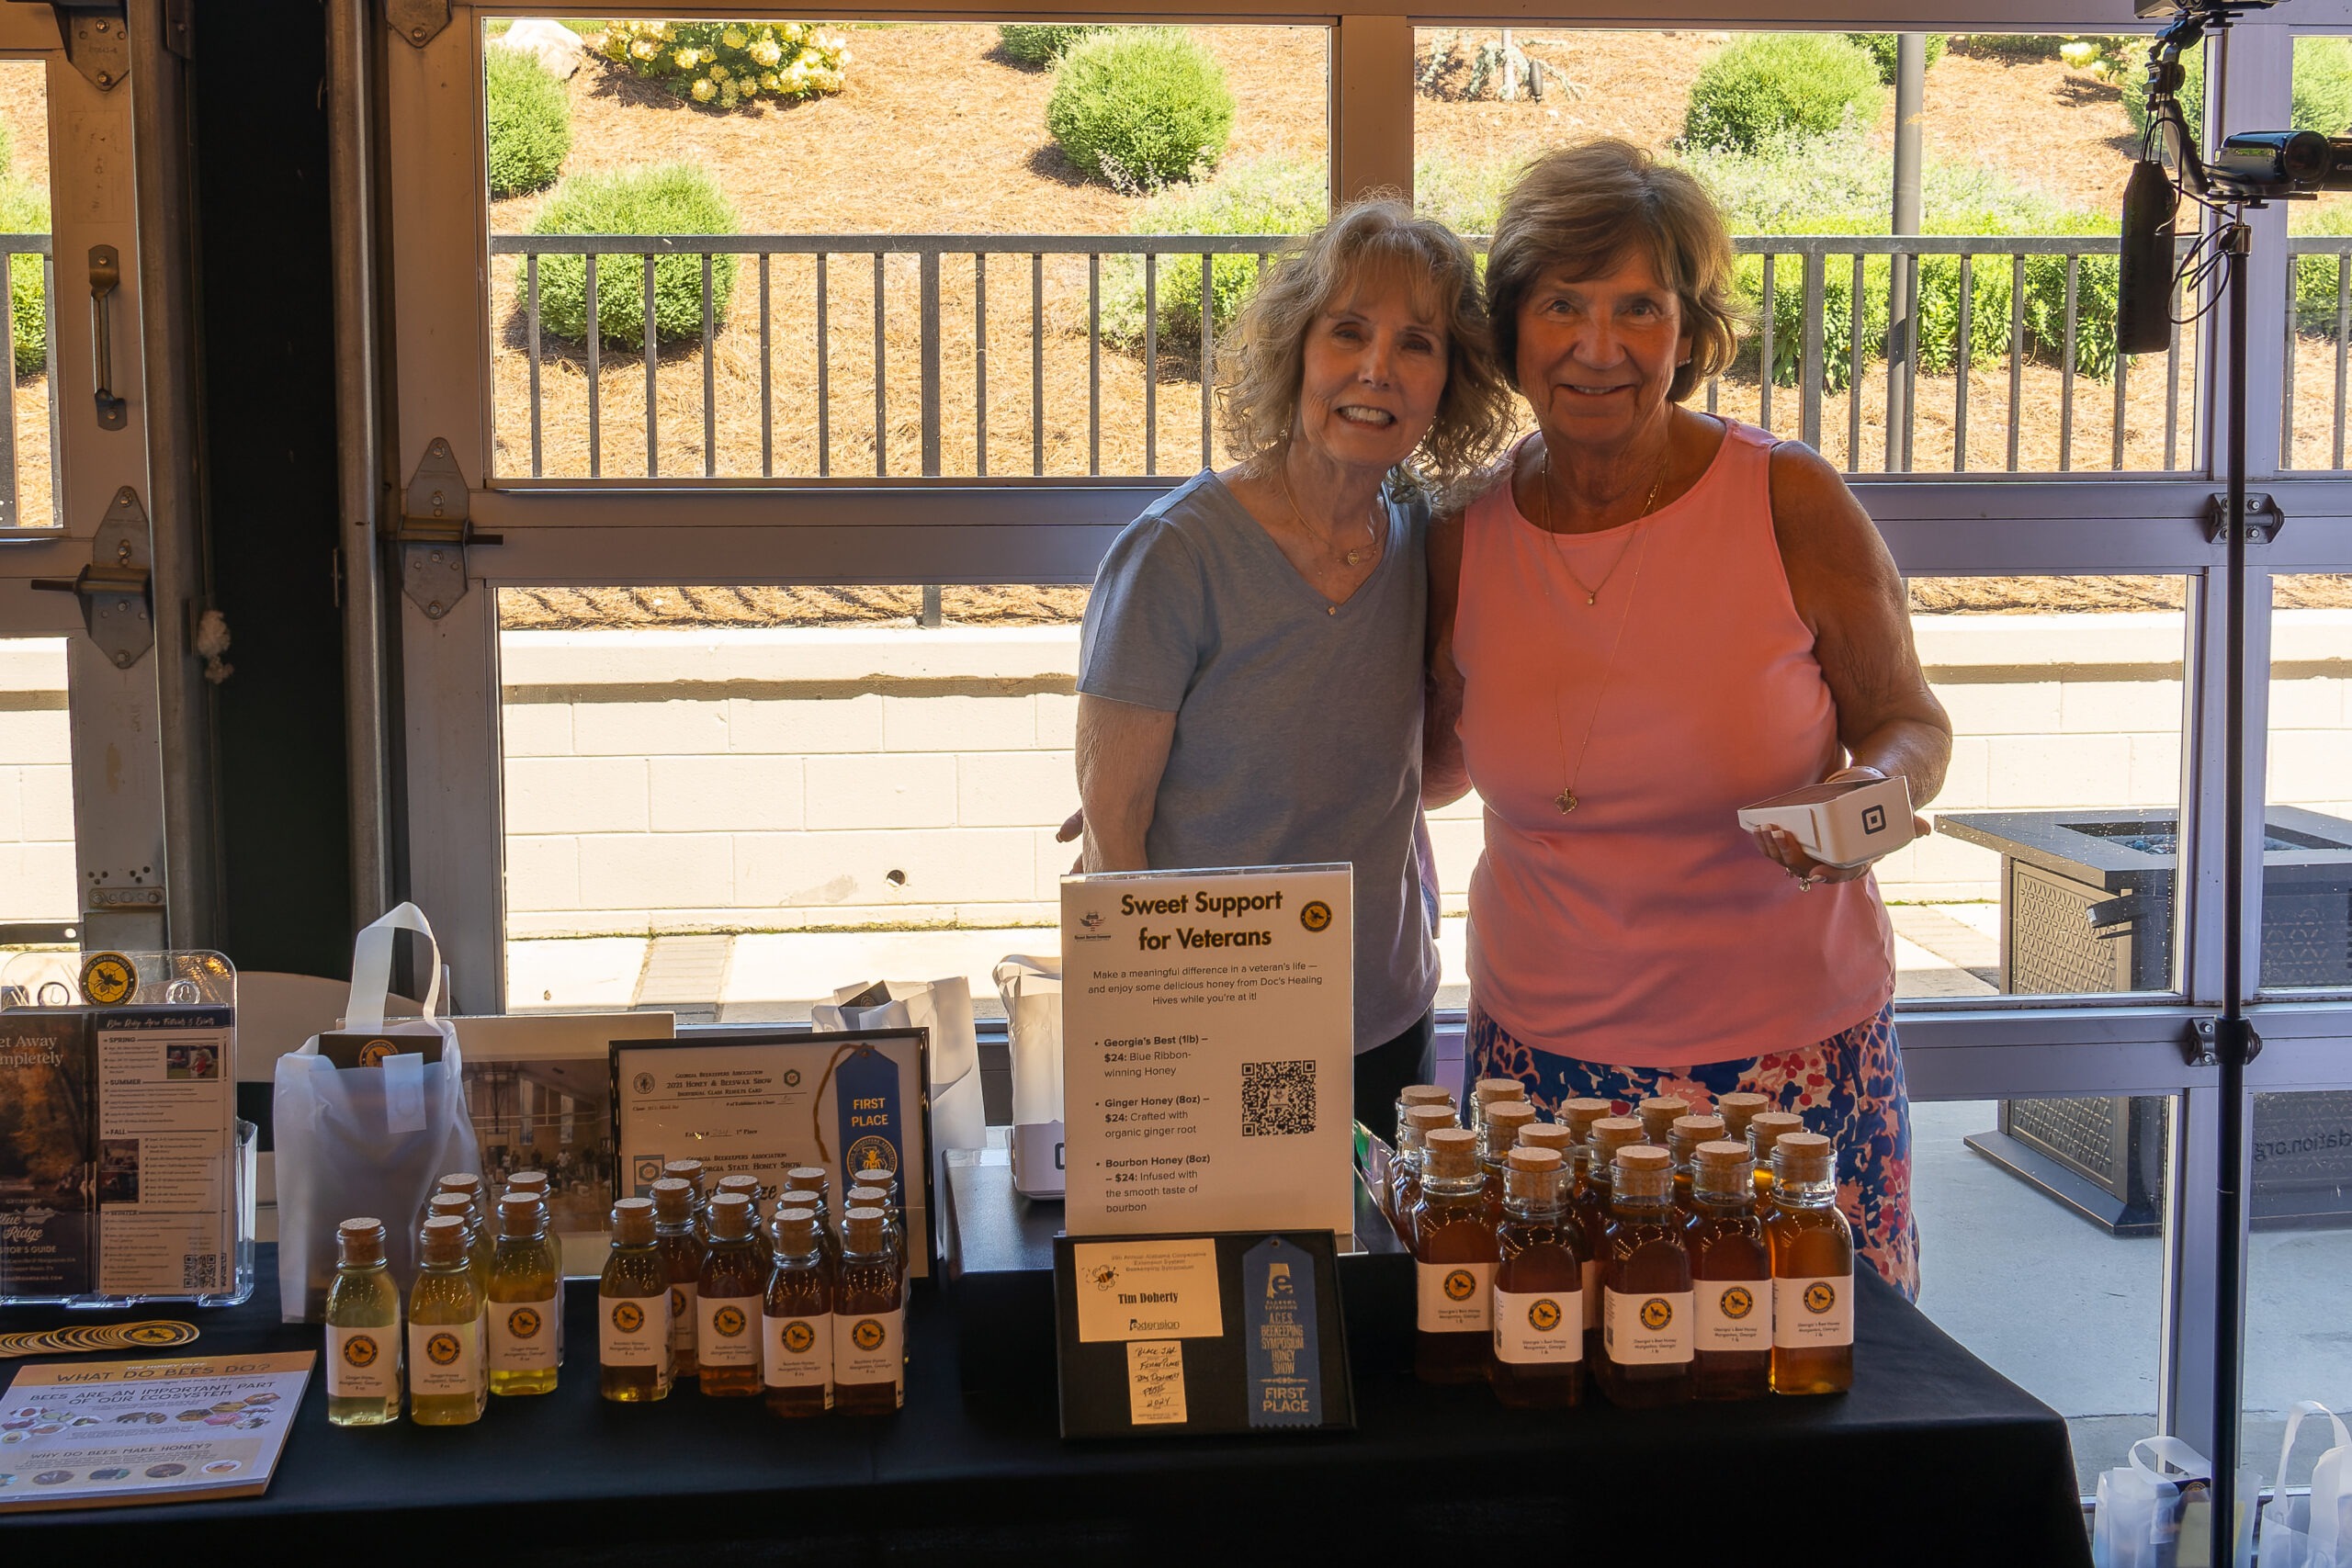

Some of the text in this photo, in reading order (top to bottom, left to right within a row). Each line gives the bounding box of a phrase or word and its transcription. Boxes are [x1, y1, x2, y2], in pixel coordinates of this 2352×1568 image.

[1121, 893, 1189, 916] Sweet
[1194, 890, 1283, 919] Support
[1138, 926, 1272, 951] for Veterans
[1093, 970, 1118, 979] Make
[1129, 967, 1180, 978] meaningful
[1182, 965, 1228, 976] difference
[1230, 965, 1238, 974] in
[1249, 963, 1291, 973] veteran's
[1293, 962, 1306, 971] life
[1088, 976, 1322, 996] and enjoy some delicious honey from Doc's Healing
[1152, 995, 1178, 1006] Hives
[1180, 993, 1204, 1004] while
[1206, 994, 1236, 1005] you're
[1238, 993, 1247, 1002] at
[0, 1035, 58, 1050] et Away
[1103, 1037, 1151, 1048] Georgia's
[1154, 1036, 1176, 1045] Best
[1179, 1034, 1199, 1045] (1lb)
[0, 1051, 63, 1068] mpletely
[1104, 1051, 1192, 1063] $24: Blue Ribbon-
[1104, 1066, 1177, 1078] winning Honey
[853, 1097, 886, 1110] FIRST
[1104, 1098, 1138, 1109] Ginger
[1140, 1097, 1173, 1107] Honey
[1176, 1095, 1201, 1106] (8oz)
[851, 1114, 888, 1127] PLACE
[1104, 1111, 1188, 1123] $24: Crafted with
[1104, 1125, 1197, 1139] organic ginger root
[1105, 1154, 1211, 1168] Bourbon Honey (8oz)
[1114, 1173, 1138, 1183] $24:
[1140, 1171, 1176, 1181] Infused
[1178, 1169, 1198, 1179] with
[1105, 1184, 1198, 1198] the smooth taste of
[1105, 1202, 1148, 1213] bourbon
[0, 1213, 21, 1225] lue
[3, 1226, 43, 1243] Ridge
[0, 1245, 57, 1255] SITOR'S GUIDE
[1117, 1292, 1179, 1304] Tim Doherty
[1261, 1337, 1305, 1350] SYMPOSIUM
[57, 1363, 271, 1382] WHAT DO BEES DO?
[1272, 1361, 1295, 1375] SHOW
[74, 1391, 107, 1399] ARE
[141, 1383, 232, 1395] IMPORTANT
[236, 1381, 276, 1390] PART
[97, 1395, 133, 1404] OUR
[140, 1390, 233, 1402] ECOSYSTEM
[1265, 1387, 1306, 1399] FIRST
[1262, 1399, 1309, 1413] PLACE
[31, 1451, 60, 1460] WHY
[122, 1446, 156, 1454] MAKE
[161, 1443, 212, 1452] HONEY?
